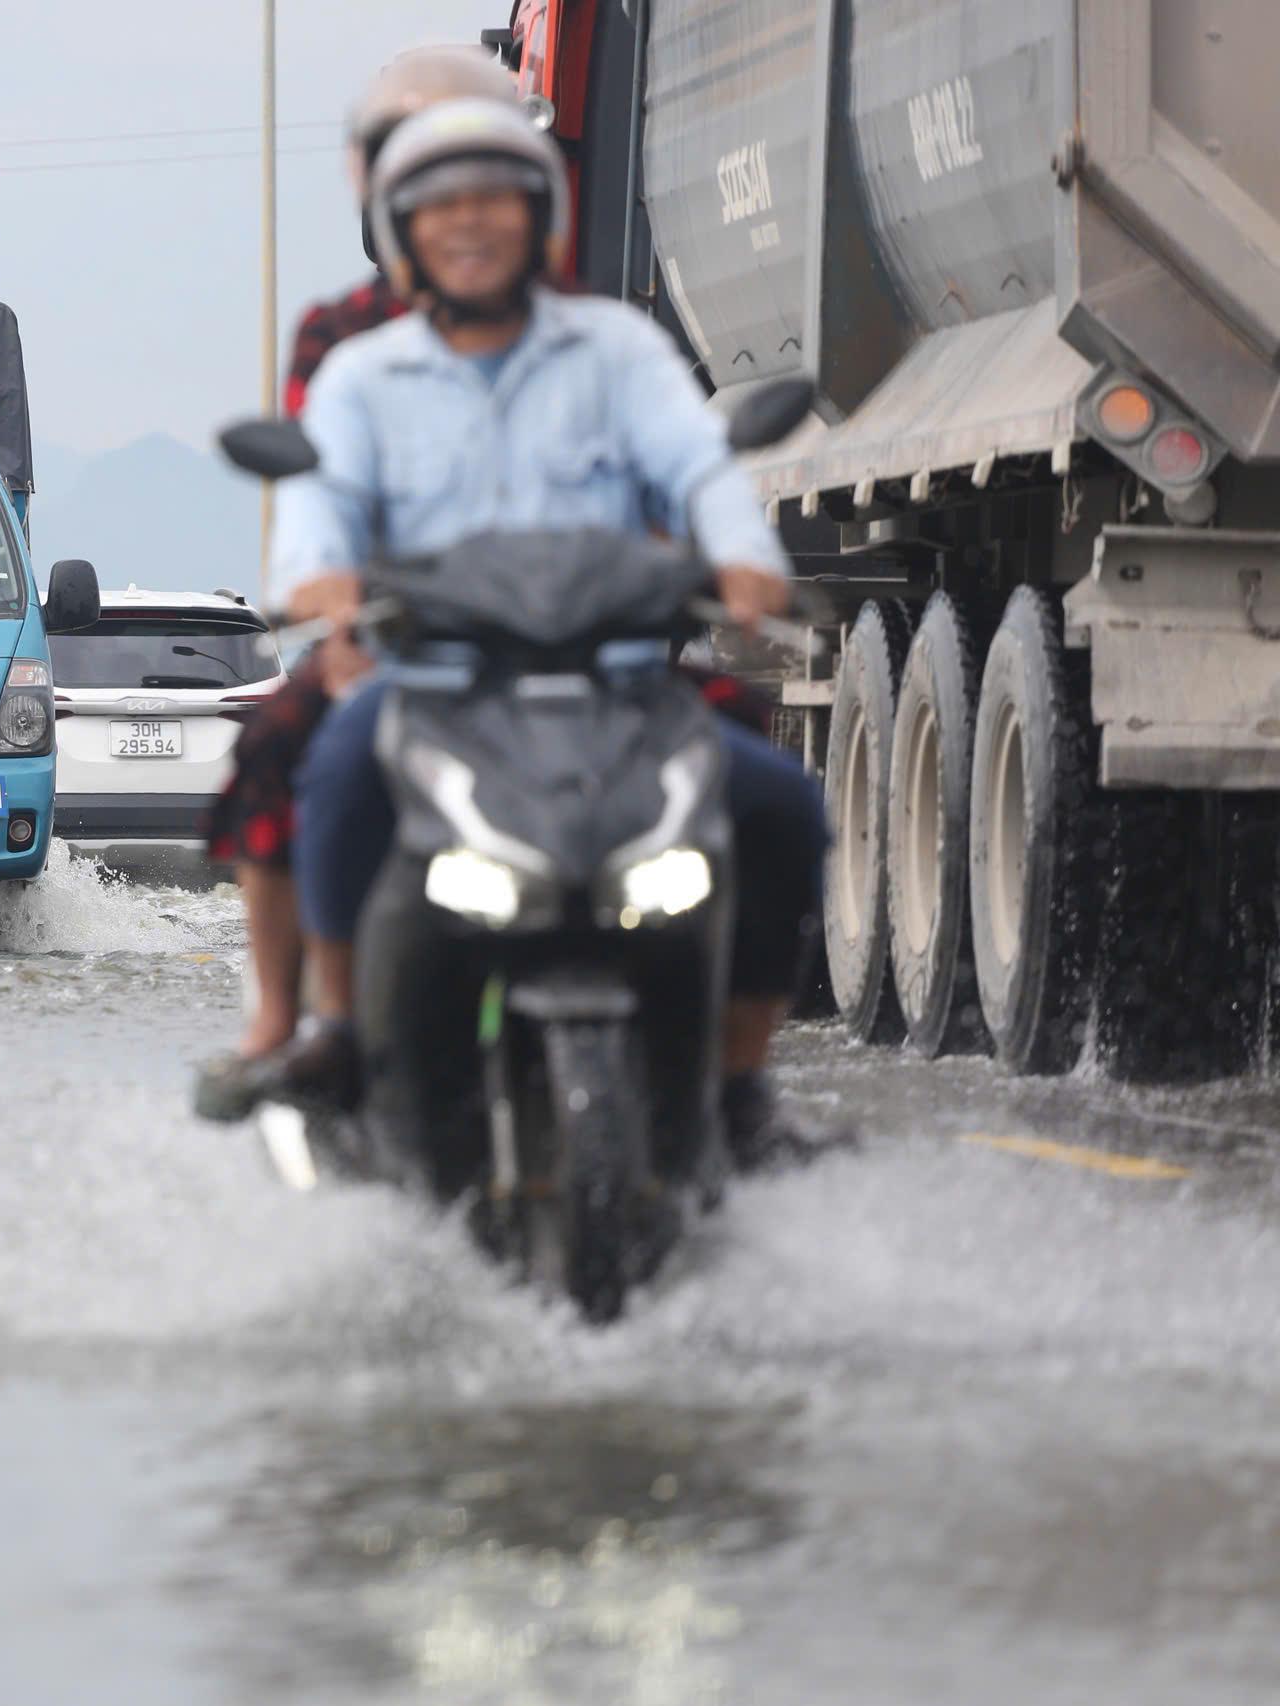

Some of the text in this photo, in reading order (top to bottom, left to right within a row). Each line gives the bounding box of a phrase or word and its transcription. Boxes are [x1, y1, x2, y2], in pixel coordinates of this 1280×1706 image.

[127, 701, 166, 711] KIA
[131, 723, 161, 737] 30H
[119, 739, 175, 754] 295.94
